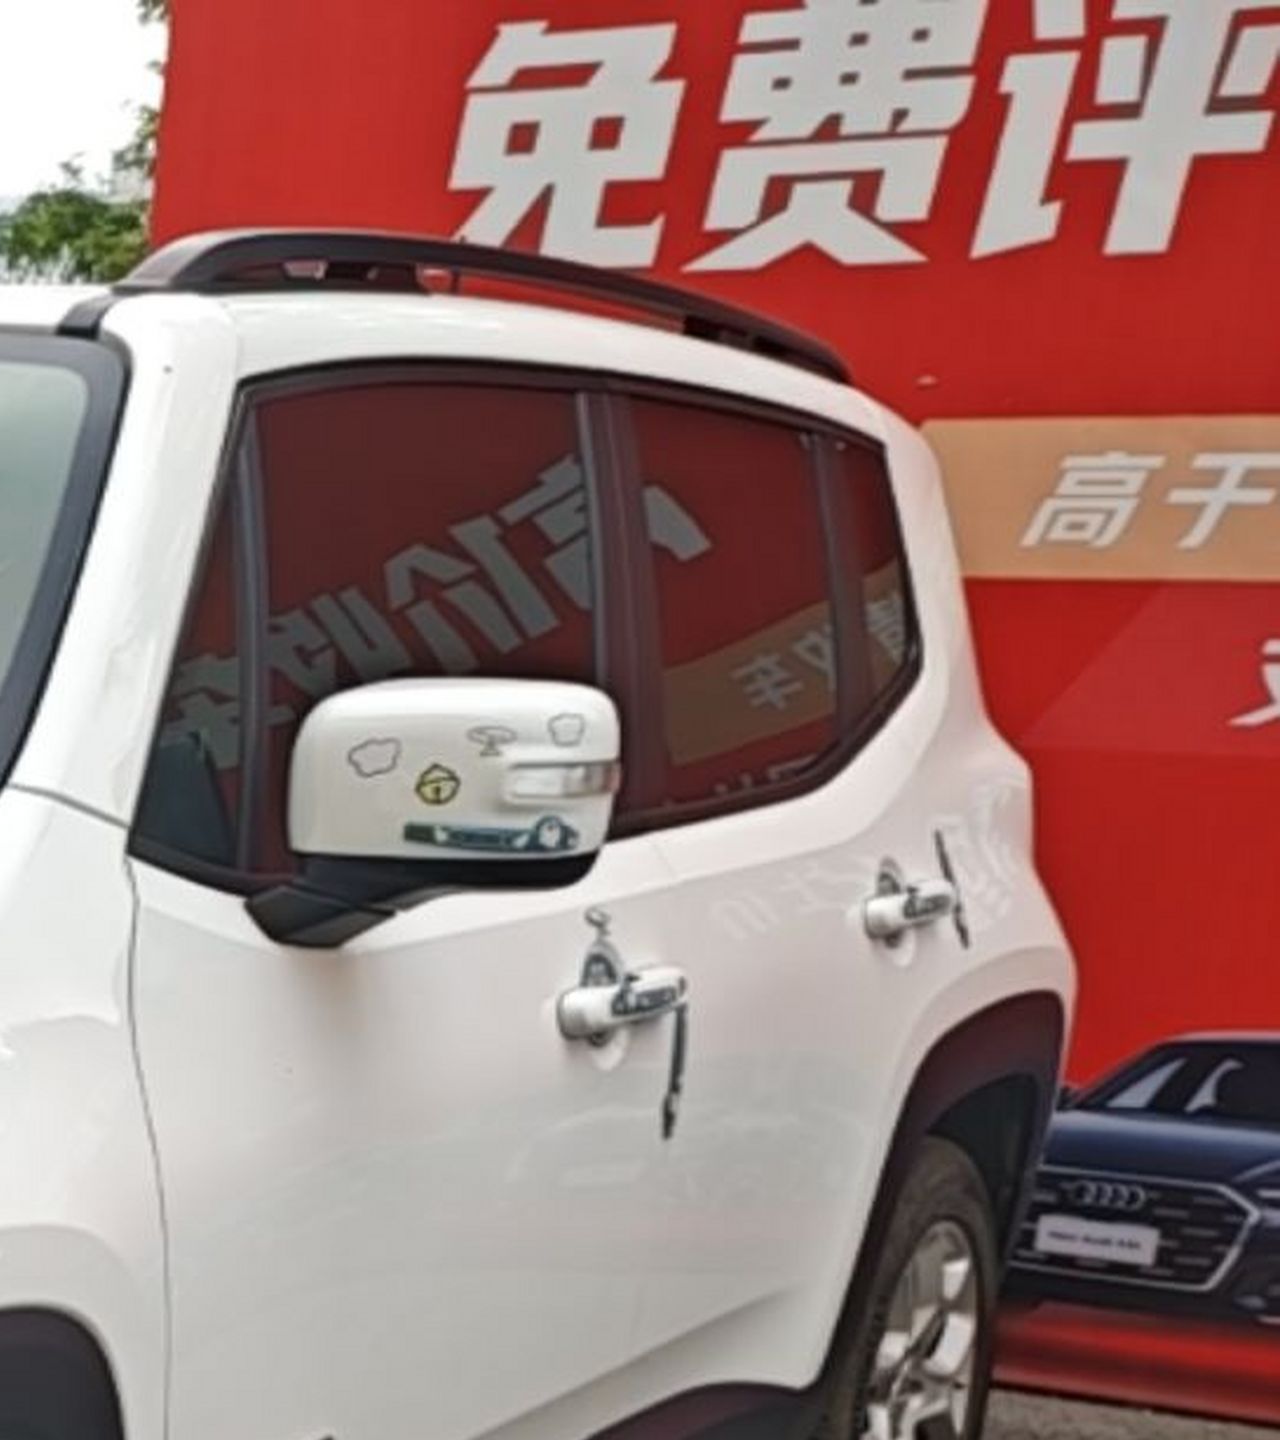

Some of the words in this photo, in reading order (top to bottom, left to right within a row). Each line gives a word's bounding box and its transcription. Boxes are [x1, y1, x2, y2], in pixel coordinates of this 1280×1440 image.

[447, 0, 1280, 271] 免费评
[1019, 450, 1280, 548] 高于
